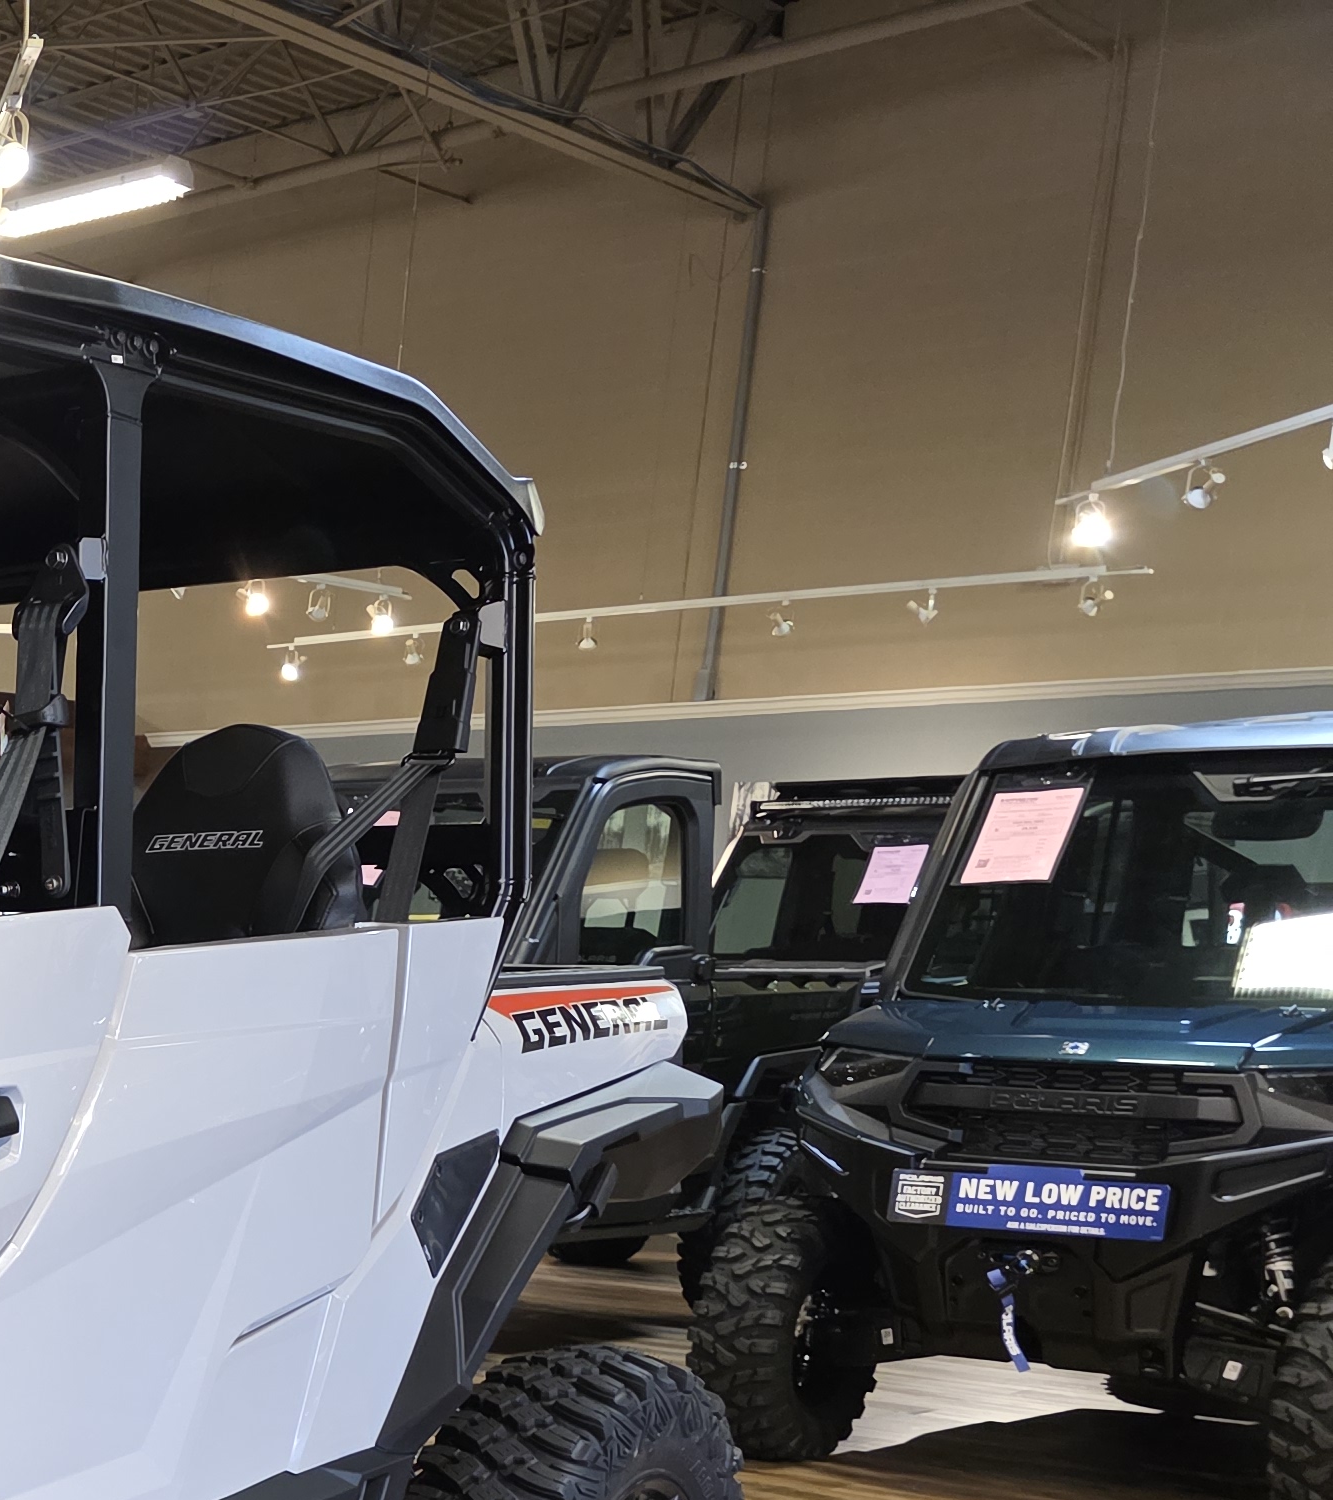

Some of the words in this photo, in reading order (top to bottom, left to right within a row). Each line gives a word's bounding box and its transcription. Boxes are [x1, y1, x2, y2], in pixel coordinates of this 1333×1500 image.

[145, 828, 264, 854] GENERAL
[989, 1090, 1138, 1115] POLARIS
[958, 1177, 1019, 1201] NEW
[1025, 1182, 1085, 1206] LOW
[1089, 1187, 1162, 1212] PRICE
[955, 1203, 995, 1215] BUILT
[999, 1206, 1016, 1217] TO
[1047, 1210, 1096, 1223] PRICED
[1101, 1213, 1117, 1224] TO
[1120, 1214, 1157, 1227] MOVE.
